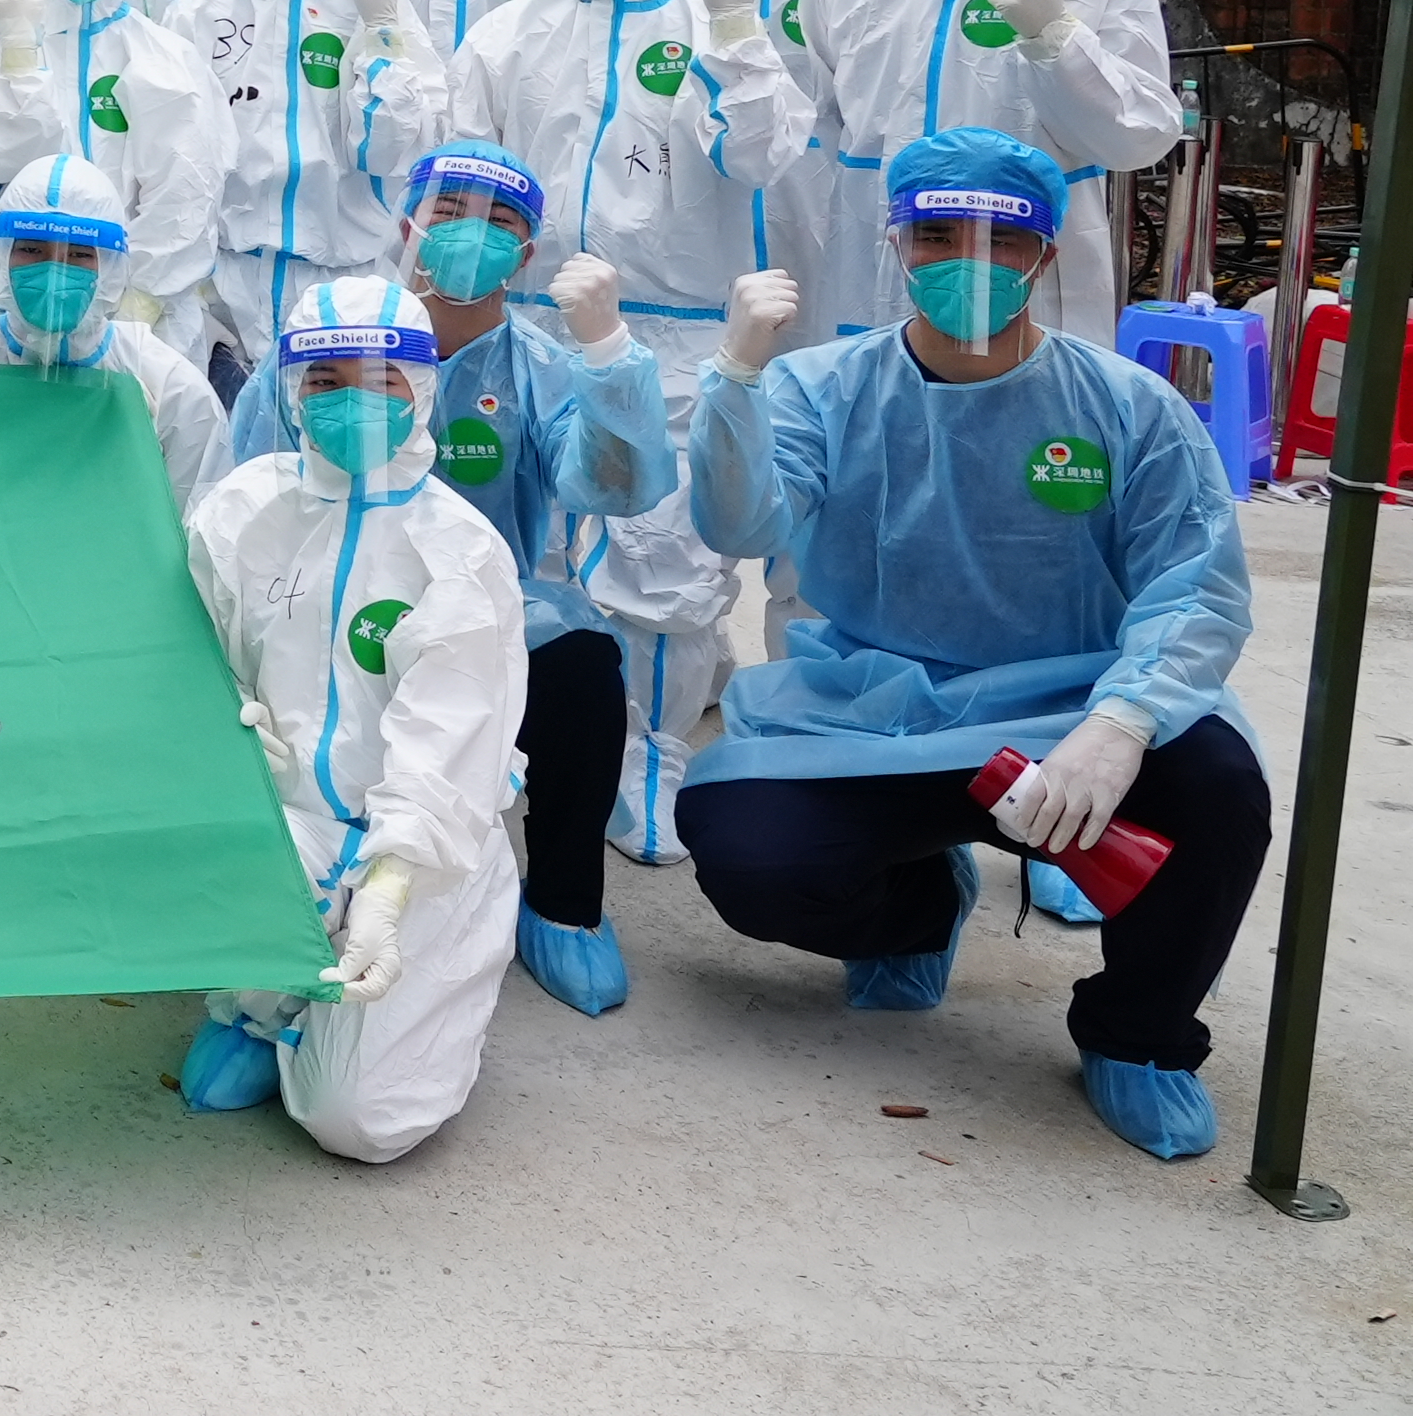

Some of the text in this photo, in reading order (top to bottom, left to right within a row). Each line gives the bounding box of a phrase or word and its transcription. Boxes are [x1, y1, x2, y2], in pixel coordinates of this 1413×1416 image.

[444, 160, 474, 173] Face
[476, 163, 516, 184] Shield
[927, 195, 1014, 210] Face Shield
[13, 219, 99, 238] Medical Face Shield
[298, 333, 379, 347] Face Shield
[456, 444, 498, 455] 深圳地铁
[1053, 466, 1105, 480] 深圳地铁
